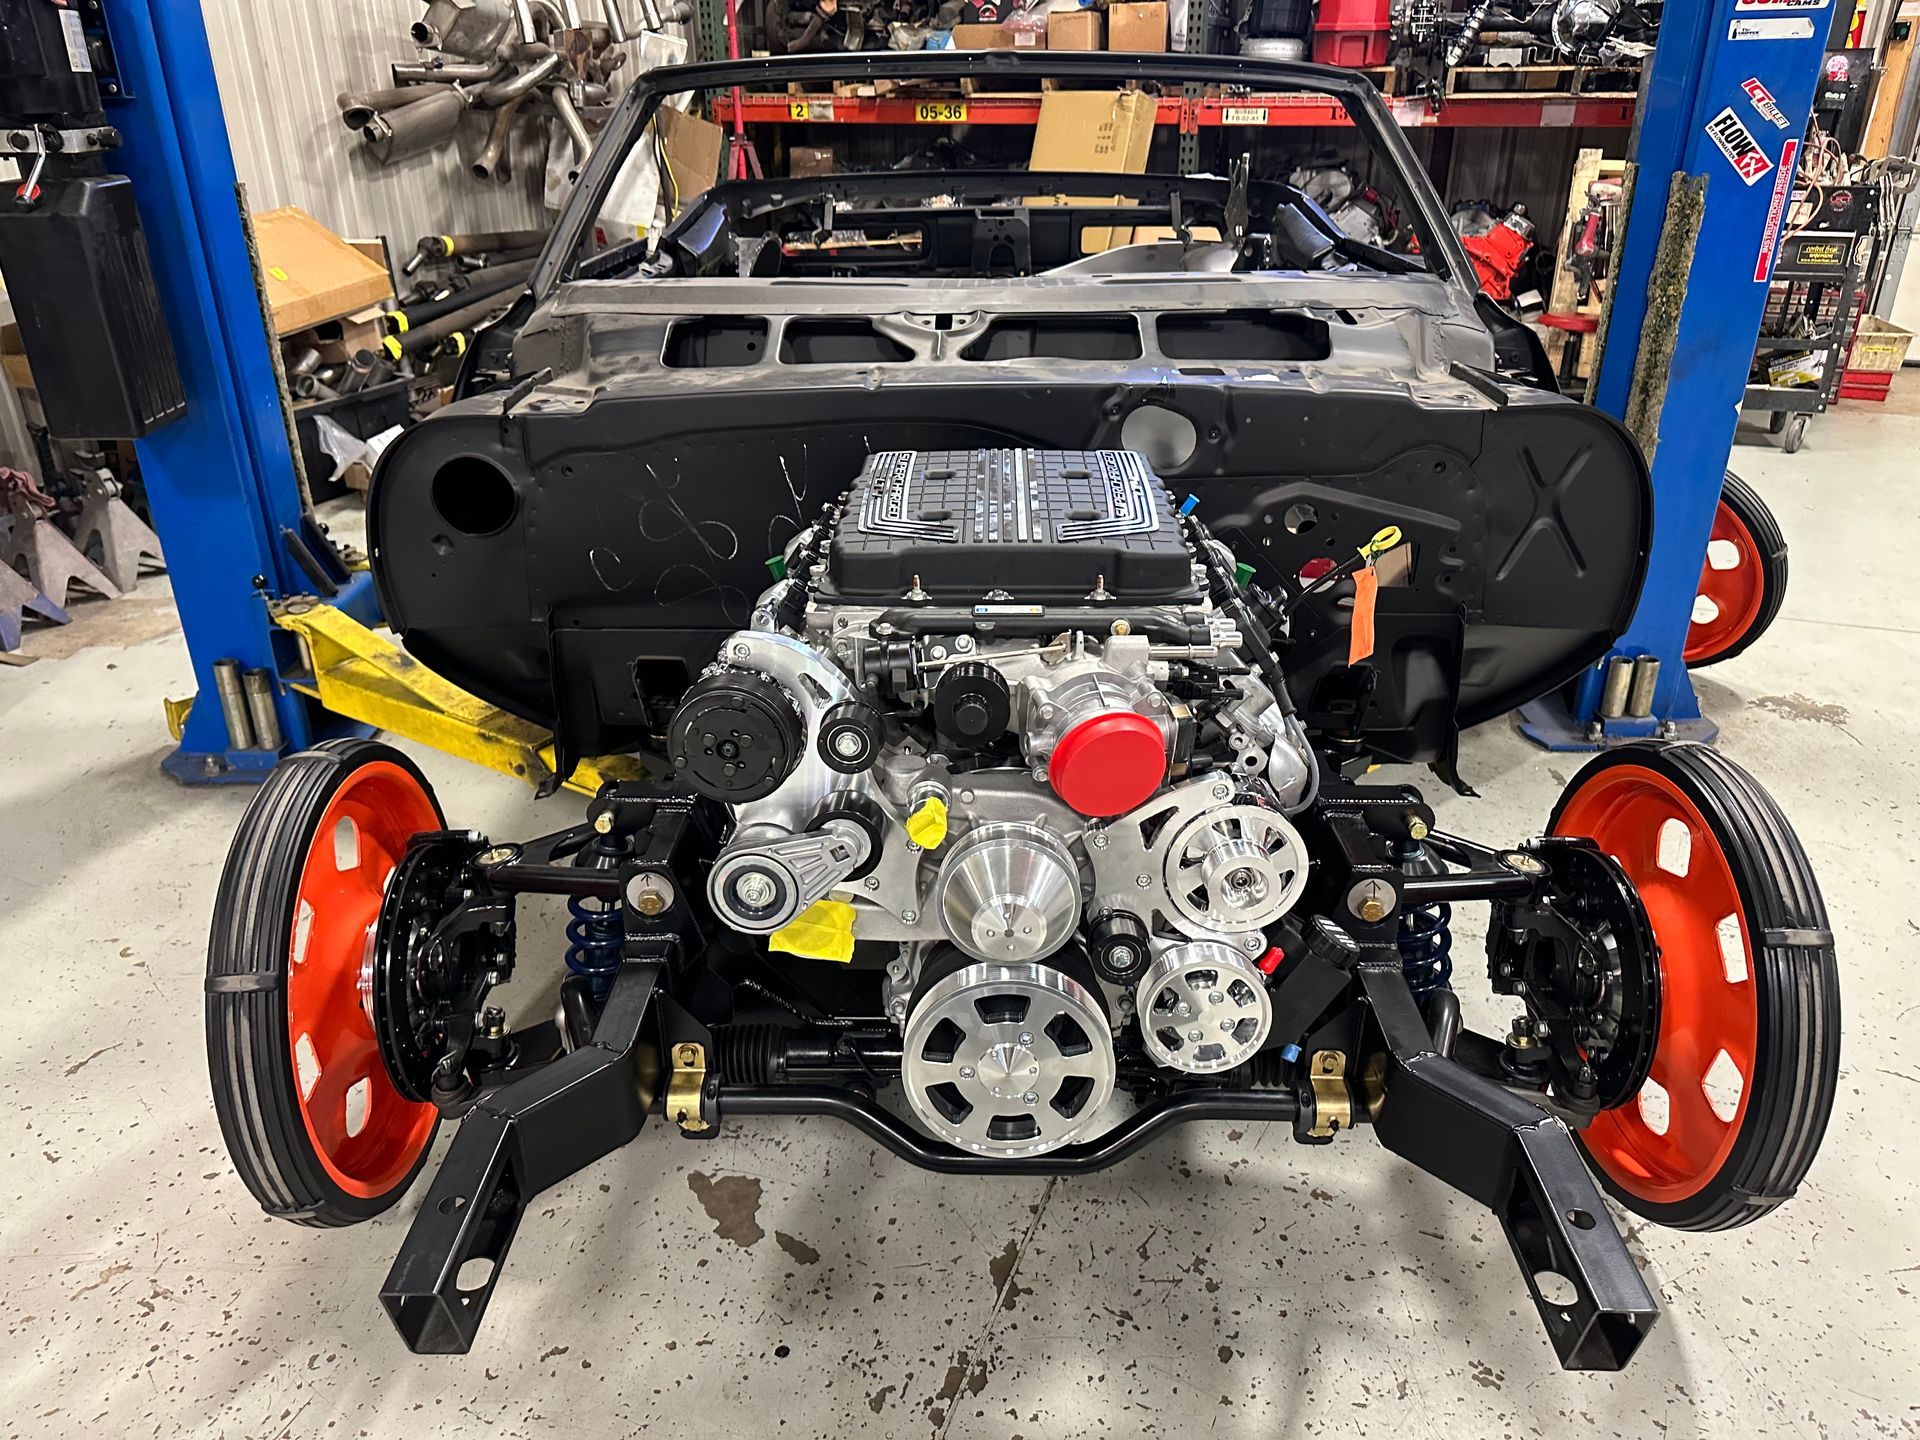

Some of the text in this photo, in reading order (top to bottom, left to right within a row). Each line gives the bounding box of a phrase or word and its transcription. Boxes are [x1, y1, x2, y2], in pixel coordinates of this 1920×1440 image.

[795, 104, 805, 117] 2
[919, 105, 962, 119] 05-36
[1742, 79, 1775, 104] ICT
[1763, 101, 1788, 127] BILLET
[1712, 131, 1736, 160] FLOWMASTER
[1762, 164, 1788, 253] INSTRUCTIONS INSIDE
[888, 452, 910, 519] SUPERCHARGED
[1102, 451, 1127, 517] SUPERCHARGED
